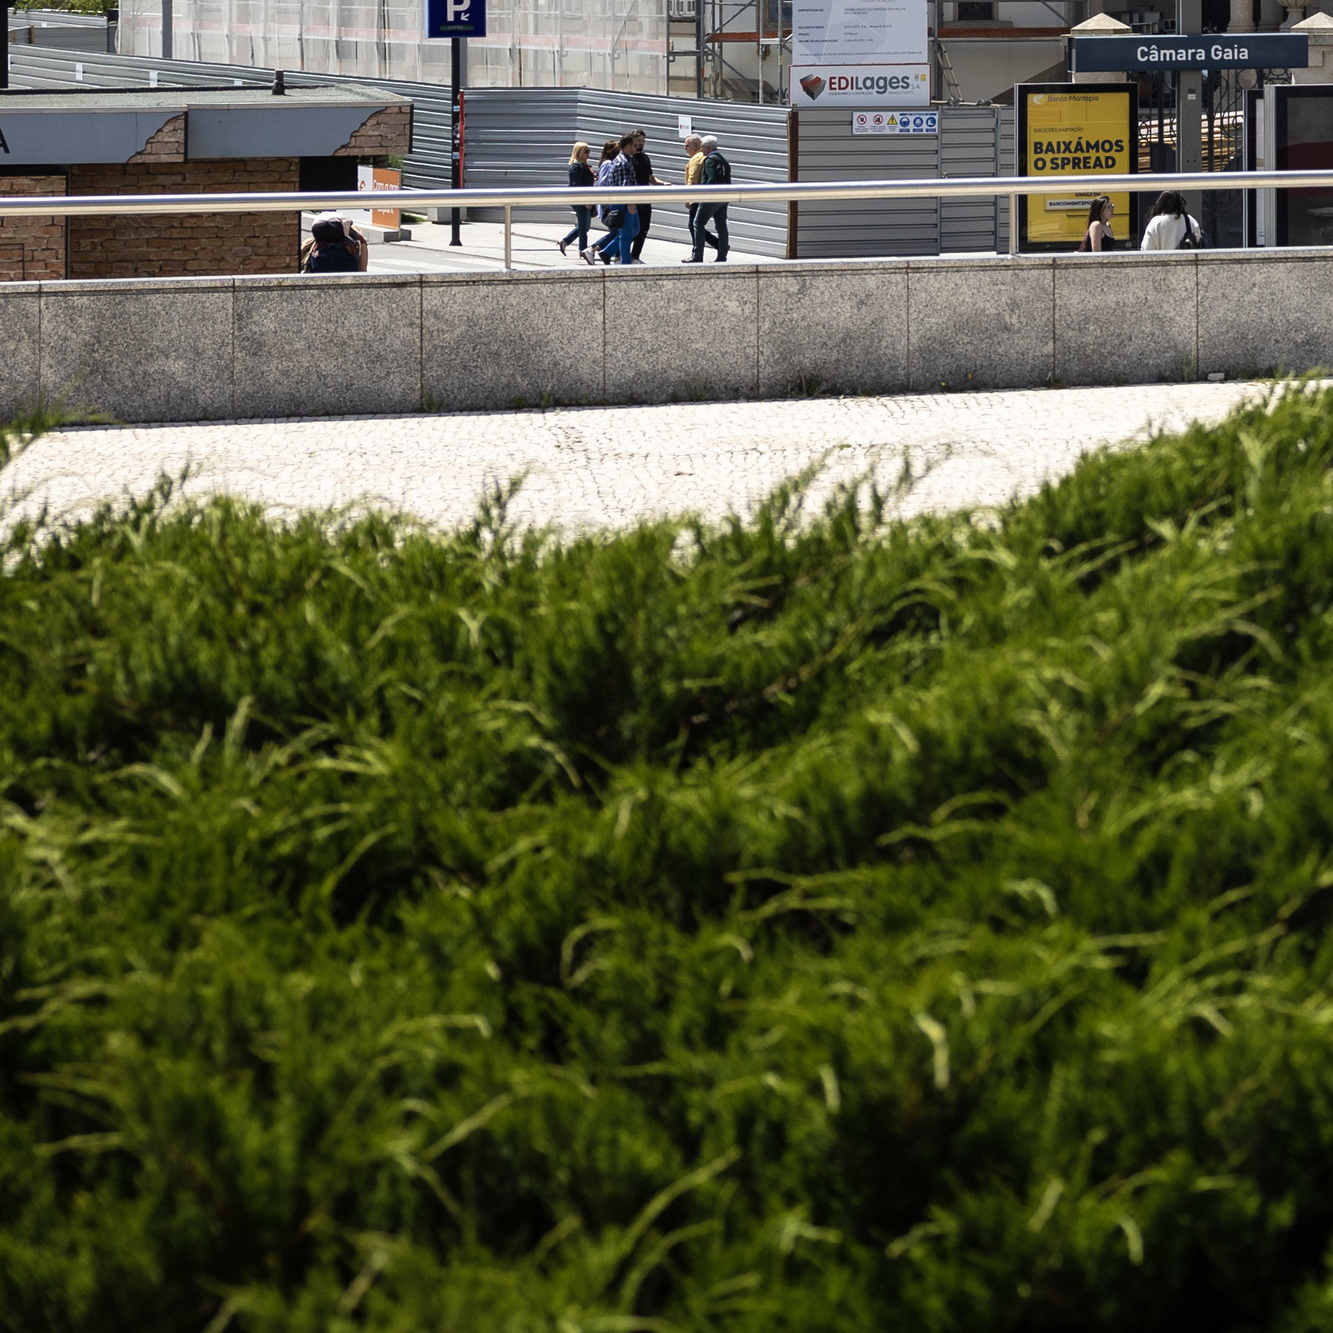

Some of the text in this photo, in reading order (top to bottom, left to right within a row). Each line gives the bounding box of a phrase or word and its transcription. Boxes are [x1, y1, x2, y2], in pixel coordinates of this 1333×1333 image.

[1136, 44, 1249, 62] Câmara Gaia
[828, 75, 910, 95] EDILages
[1047, 94, 1099, 103] Banco Montepio
[1033, 136, 1125, 155] BAIXÁMOS
[1033, 155, 1117, 171] O SPREAD
